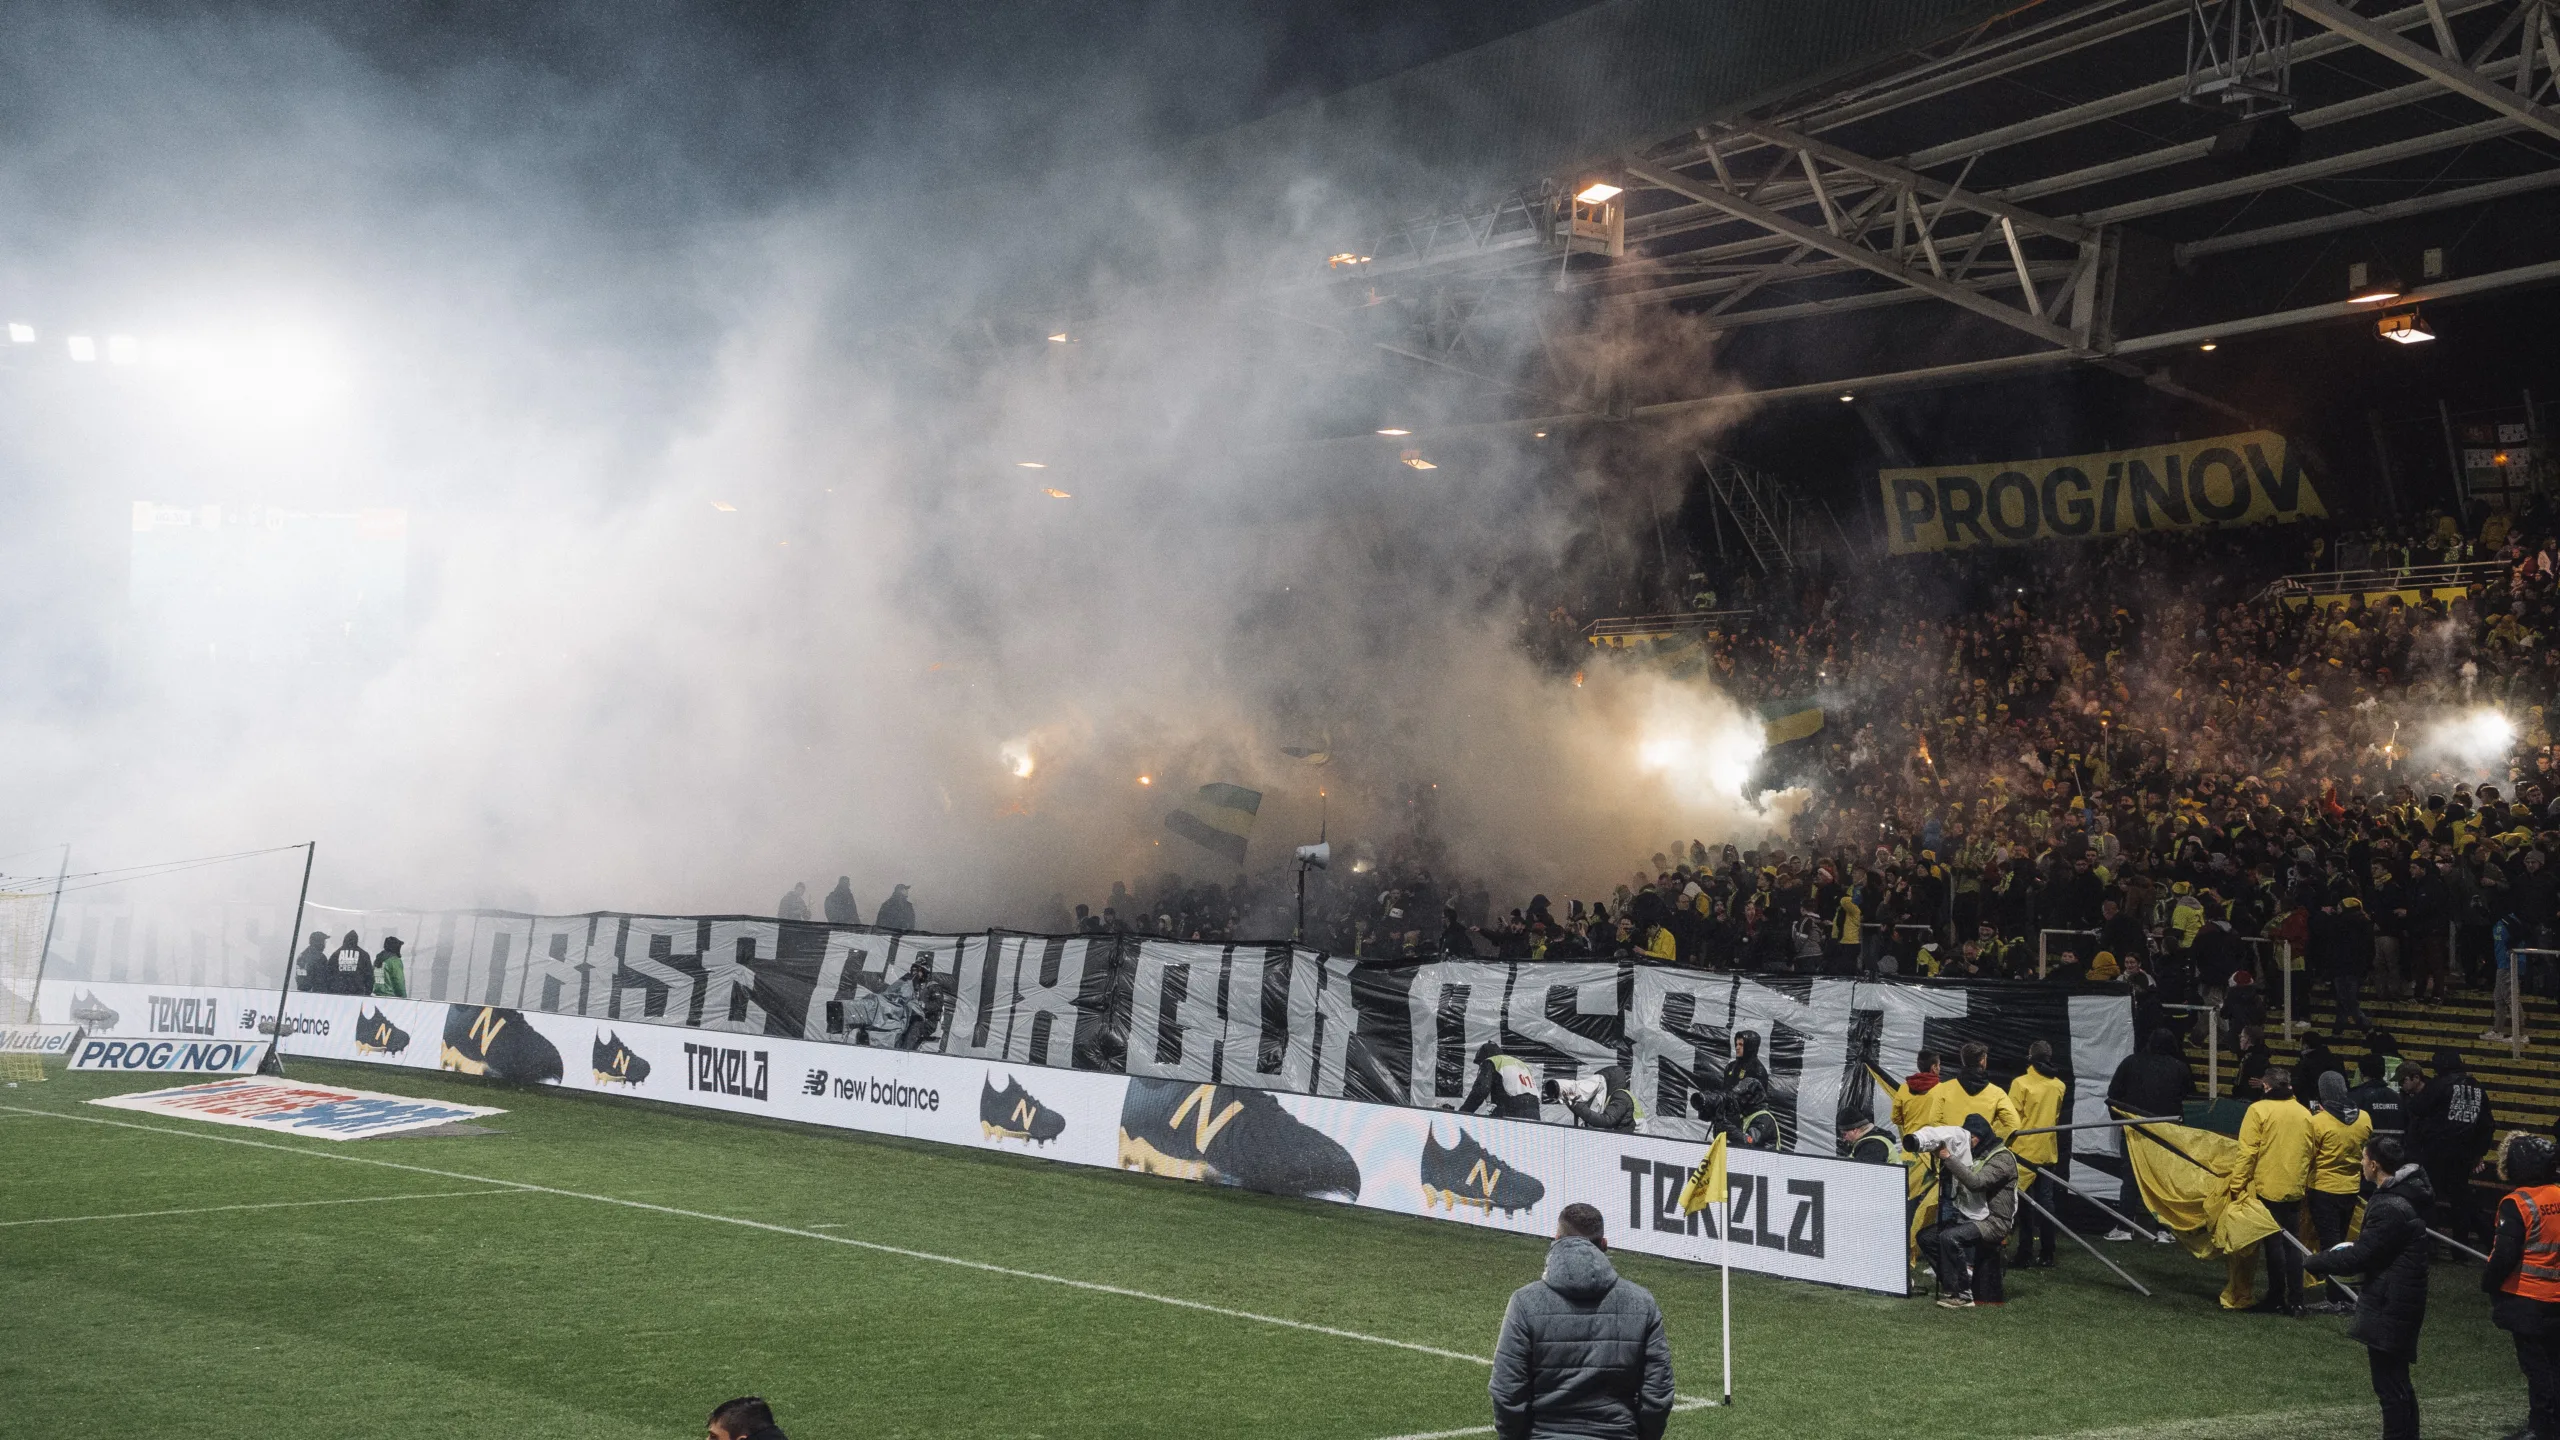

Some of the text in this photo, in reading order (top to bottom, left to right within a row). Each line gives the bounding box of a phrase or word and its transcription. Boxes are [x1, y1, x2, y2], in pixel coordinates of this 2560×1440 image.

[684, 1042, 768, 1102] TEKELA
[834, 1077, 867, 1102] new
[871, 1076, 939, 1112] balance
